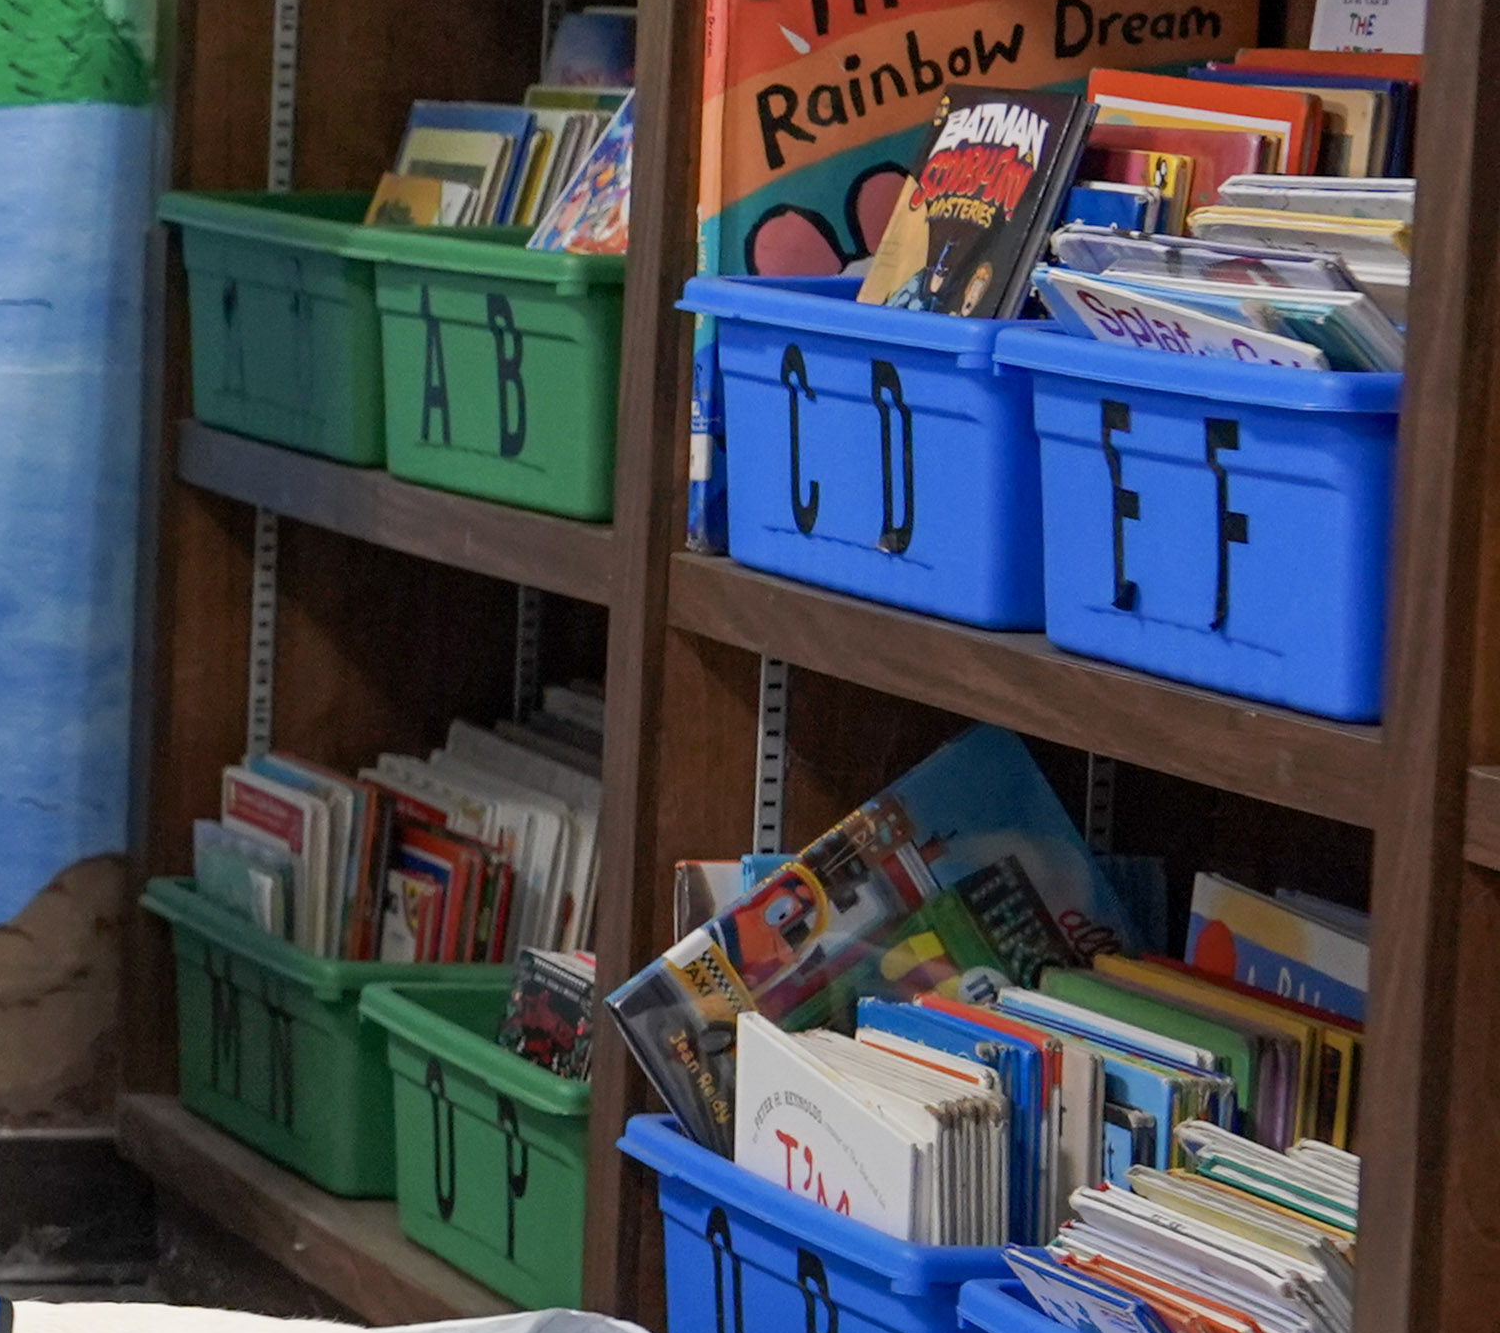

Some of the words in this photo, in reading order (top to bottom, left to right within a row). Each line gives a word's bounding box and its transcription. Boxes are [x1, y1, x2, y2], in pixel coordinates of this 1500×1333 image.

[1349, 12, 1377, 36] THE
[756, 23, 1025, 171] Rainbow
[928, 103, 1049, 171] BATMAN
[930, 196, 997, 229] MYSTERIES
[668, 1029, 700, 1074] Jean
